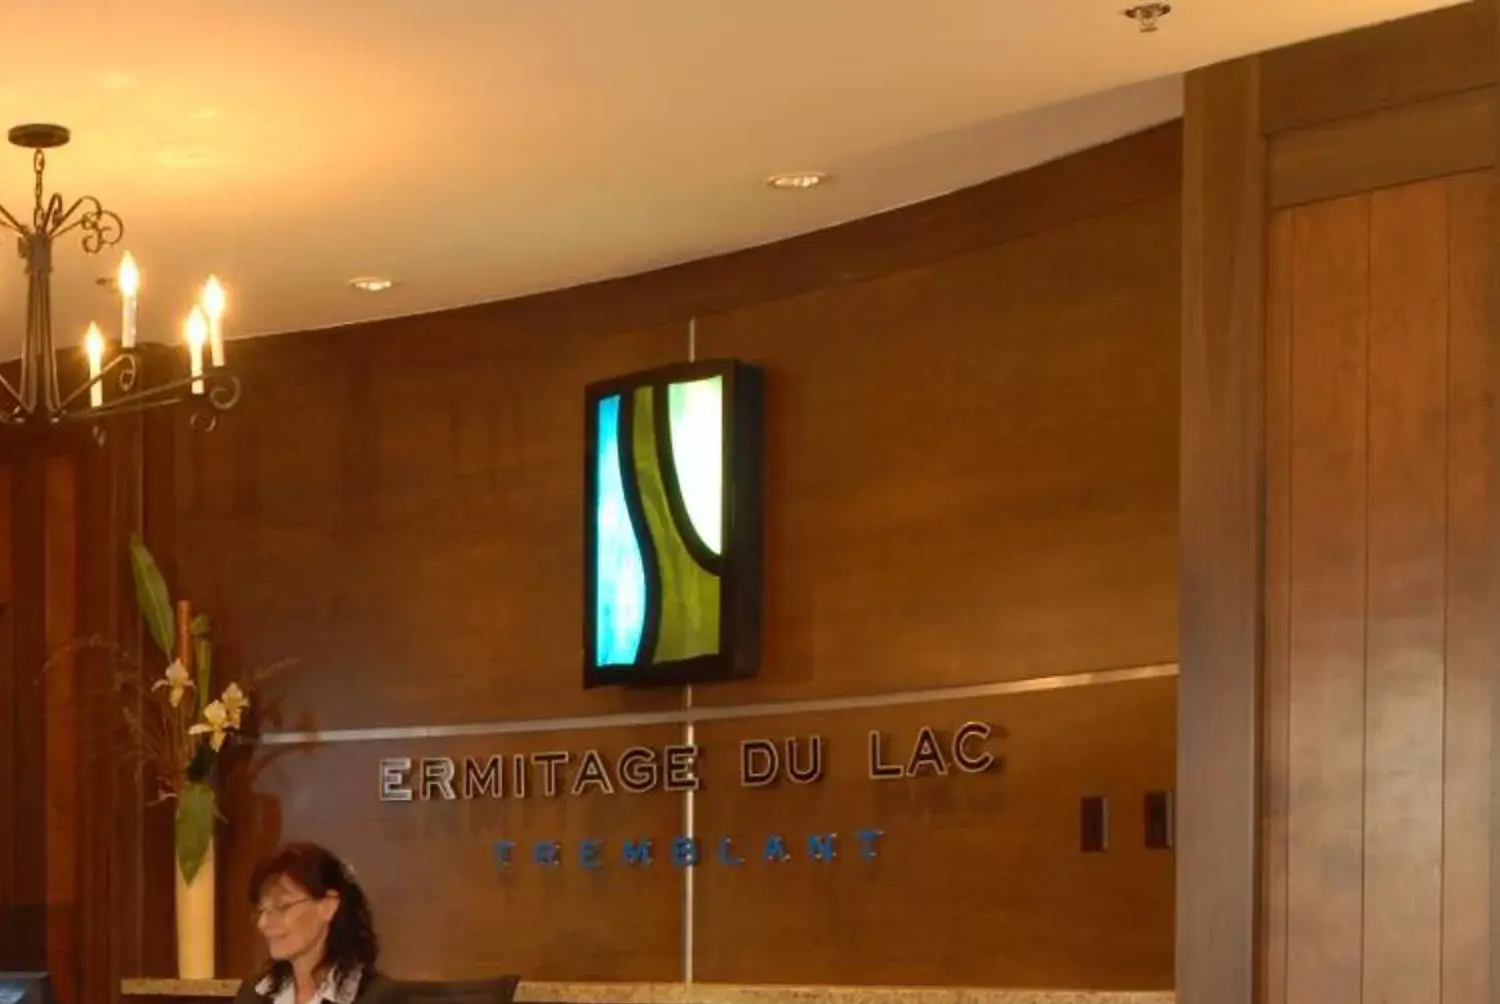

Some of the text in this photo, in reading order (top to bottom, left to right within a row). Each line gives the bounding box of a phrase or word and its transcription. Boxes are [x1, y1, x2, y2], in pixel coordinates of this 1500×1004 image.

[378, 721, 995, 802] ERMITAGE DU LAC
[492, 829, 886, 870] TREMBLANT
